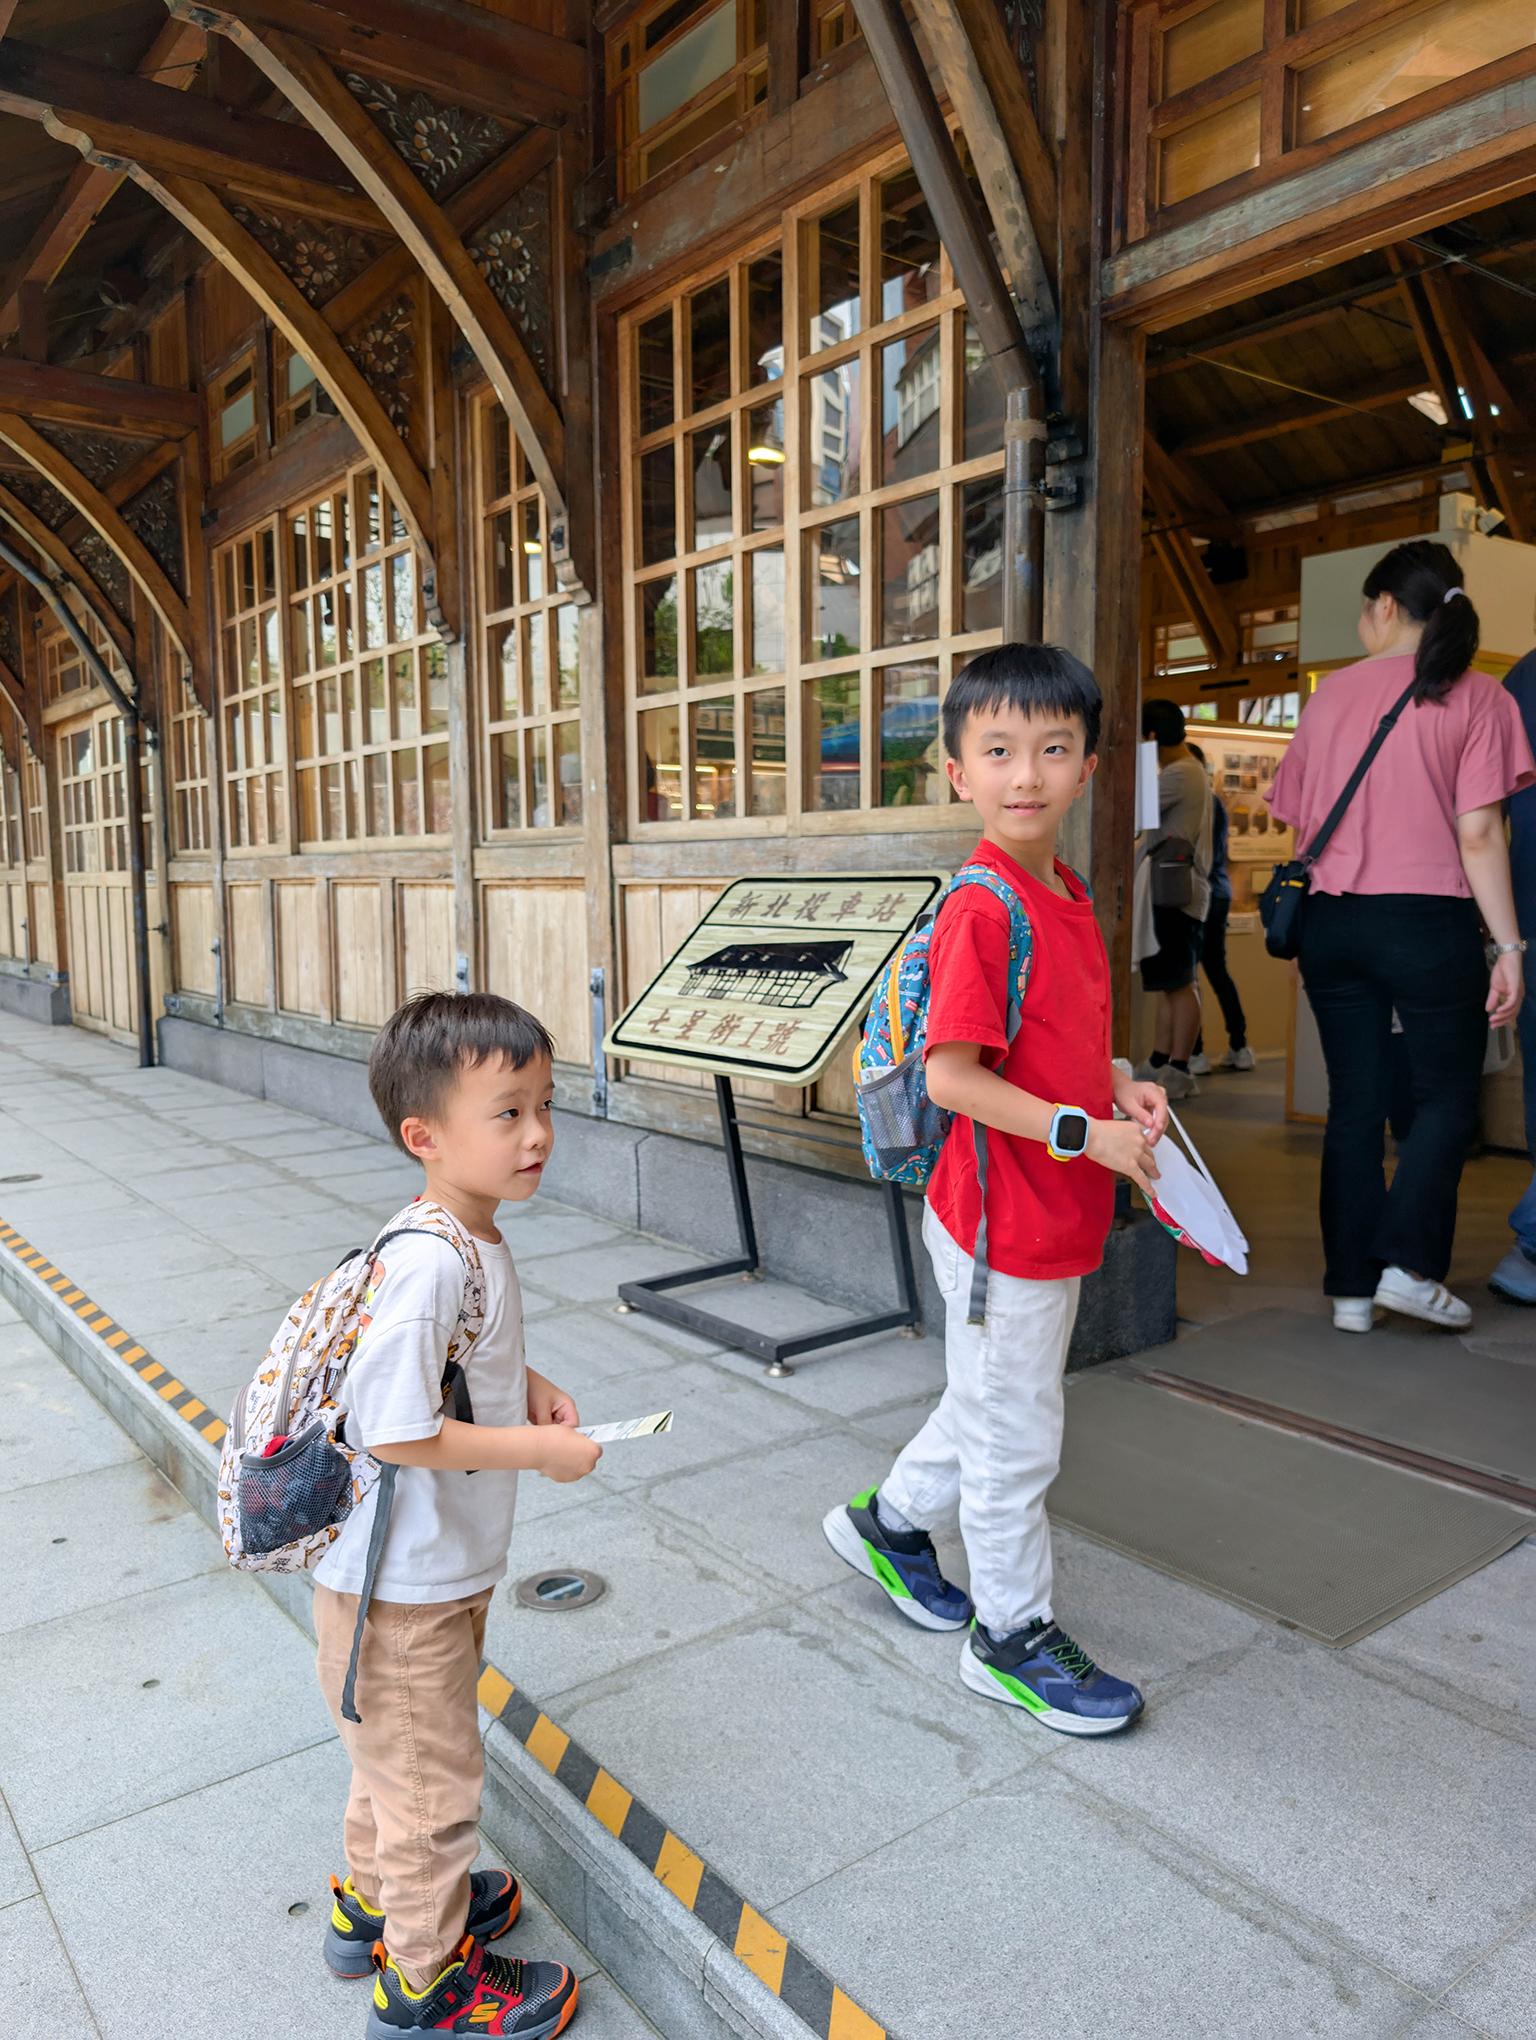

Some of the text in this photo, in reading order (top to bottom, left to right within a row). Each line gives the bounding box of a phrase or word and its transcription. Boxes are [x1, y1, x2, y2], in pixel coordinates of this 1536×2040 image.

[730, 891, 906, 923] 新北投車站
[648, 1009, 801, 1055] 七星街1號
